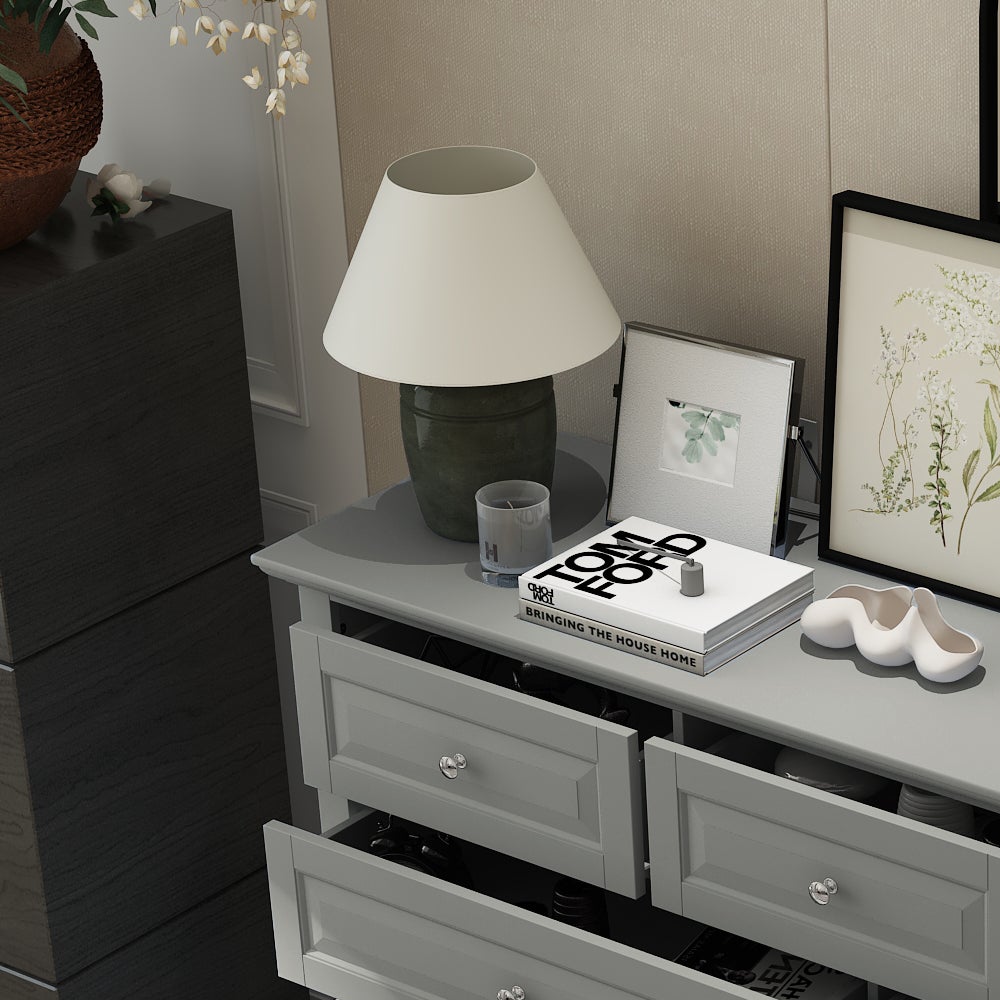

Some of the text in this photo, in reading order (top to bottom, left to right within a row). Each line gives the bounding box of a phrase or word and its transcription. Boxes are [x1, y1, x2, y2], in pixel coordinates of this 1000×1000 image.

[533, 530, 656, 582] TOM
[574, 533, 707, 599] FORD
[527, 583, 554, 597] FORD
[533, 591, 555, 605] TOM
[526, 606, 697, 668] BRINGING THE HOUSE HOME
